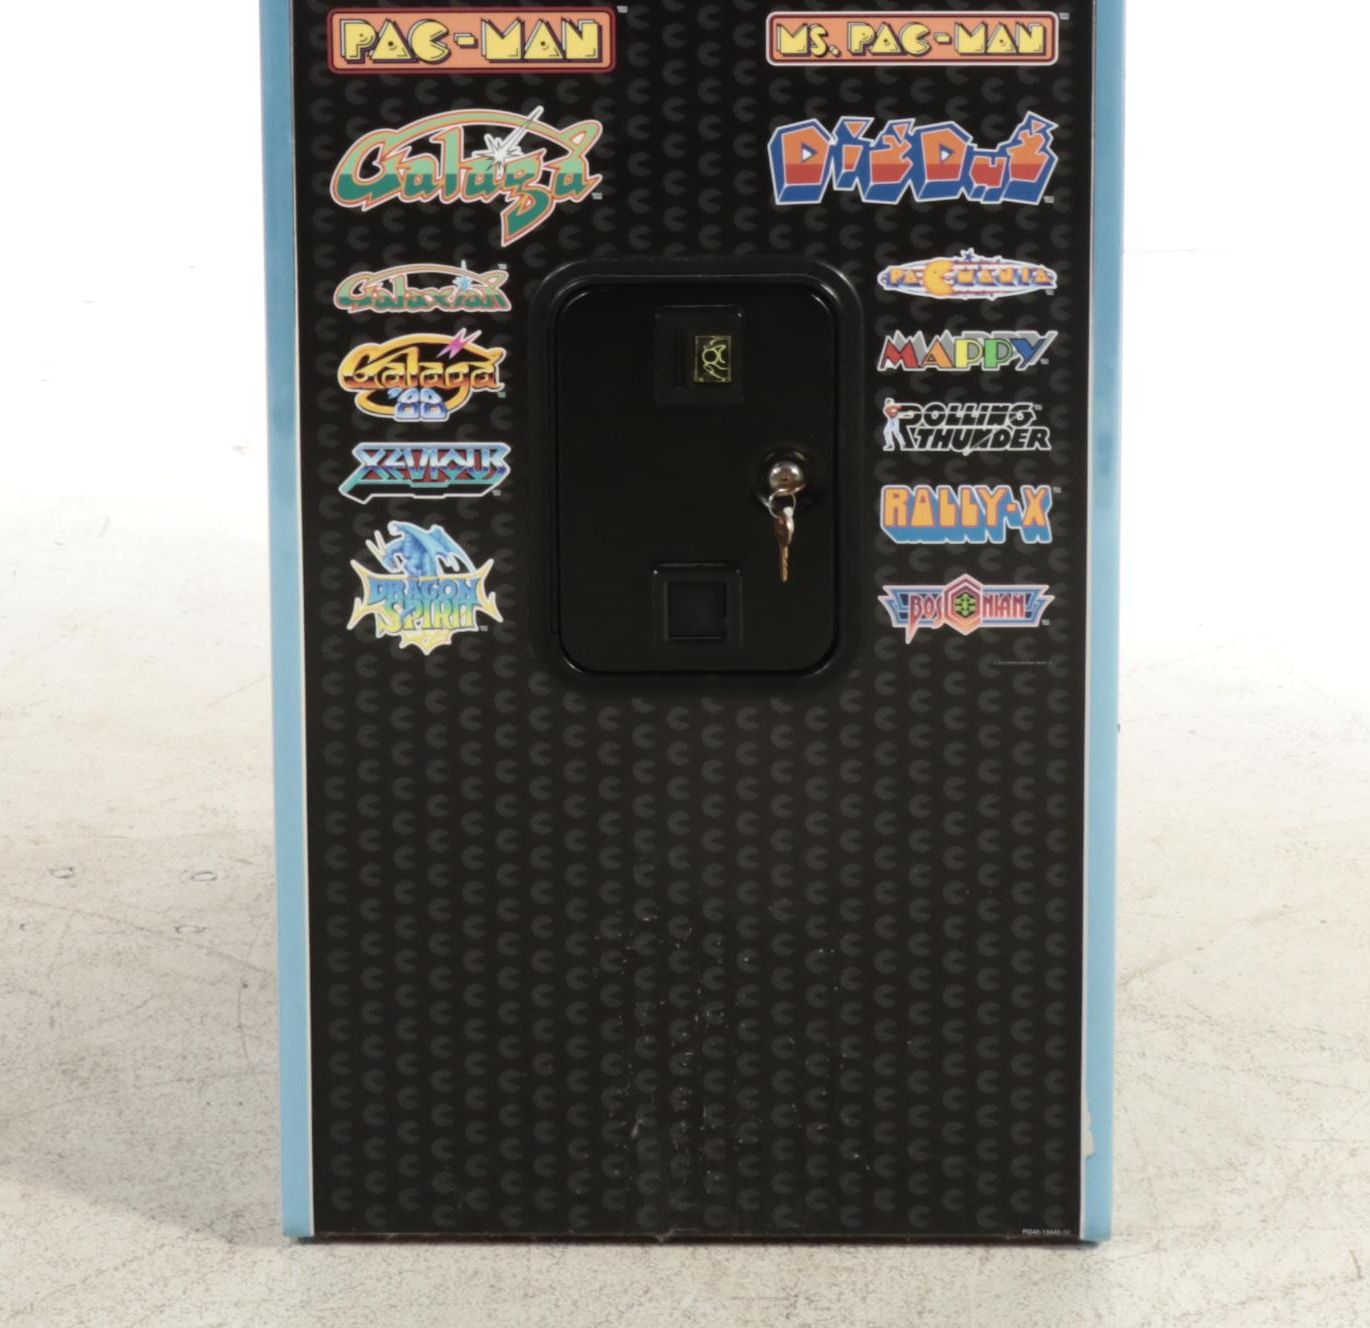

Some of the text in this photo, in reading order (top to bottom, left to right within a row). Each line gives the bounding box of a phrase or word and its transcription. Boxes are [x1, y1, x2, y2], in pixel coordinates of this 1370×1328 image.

[338, 16, 602, 65] PAC-MAN
[775, 21, 1047, 57] MS. PAC-MAN
[877, 330, 1058, 371] MAPPY
[912, 427, 1052, 453] THUNDER
[881, 485, 1052, 544] RALLY-X
[367, 577, 481, 608] DRAGON
[374, 598, 480, 634] SPIRIT
